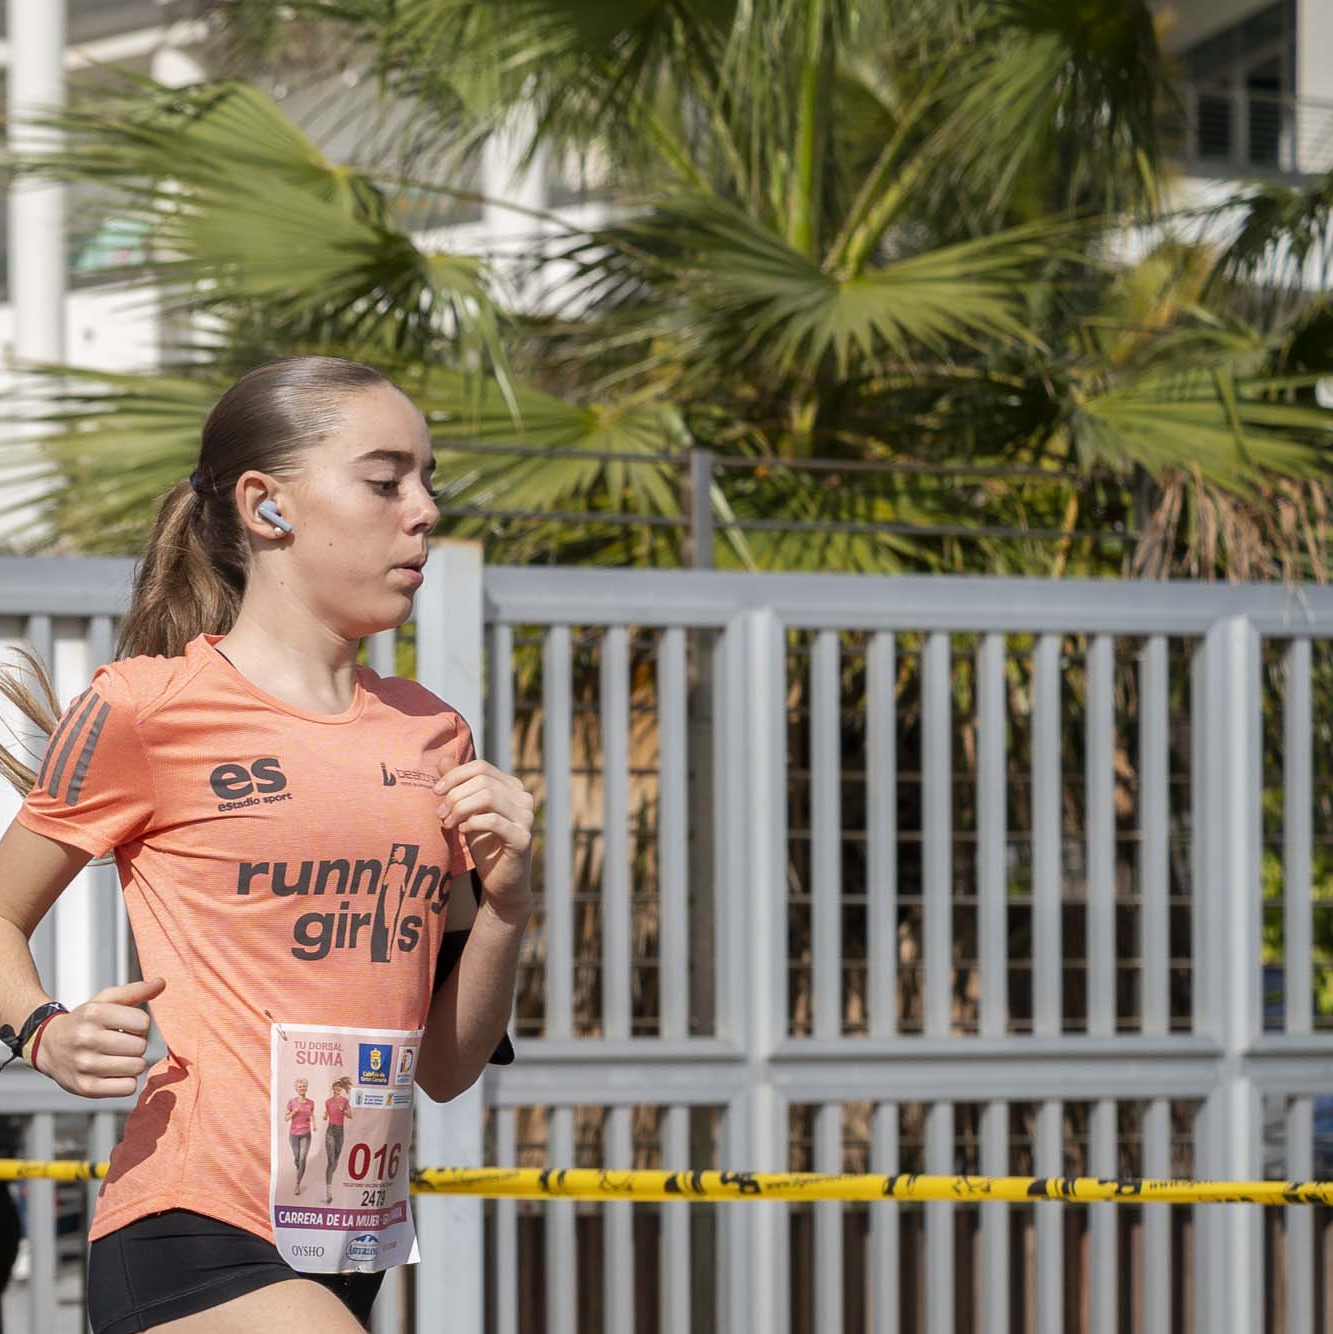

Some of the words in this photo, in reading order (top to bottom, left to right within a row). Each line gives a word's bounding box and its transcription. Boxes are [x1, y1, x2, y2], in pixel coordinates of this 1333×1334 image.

[209, 757, 287, 800] es
[263, 792, 293, 806] sport
[294, 1041, 306, 1050] TU
[309, 1041, 344, 1051] DORSAL
[295, 1050, 343, 1067] SUMA
[348, 1143, 402, 1180] 016
[278, 1211, 323, 1225] CARRERA
[326, 1213, 340, 1226] DE
[342, 1215, 354, 1227] LA
[291, 1245, 325, 1257] OYSHO
